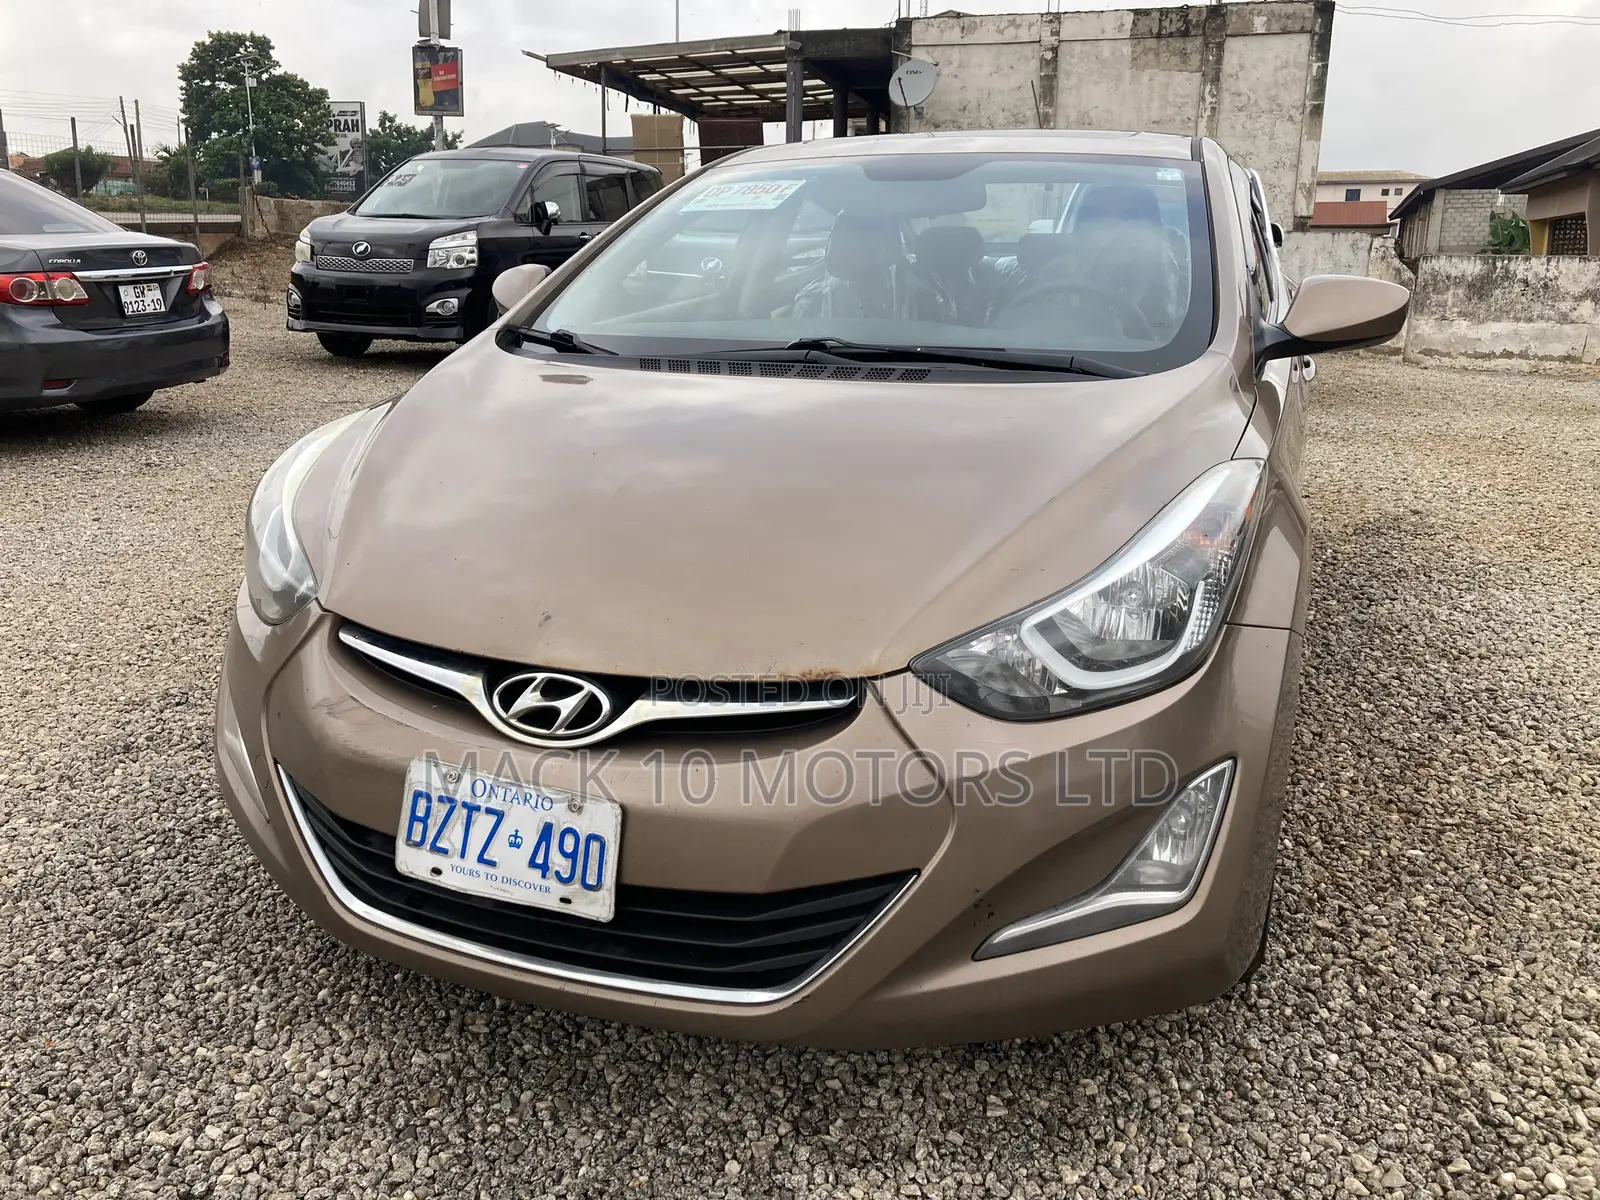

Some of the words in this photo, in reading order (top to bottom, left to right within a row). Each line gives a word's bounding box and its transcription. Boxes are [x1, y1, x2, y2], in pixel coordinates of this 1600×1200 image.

[133, 285, 146, 298] GW
[123, 298, 163, 314] 9123-19
[405, 789, 505, 868] BZTZ
[527, 821, 607, 892] 490
[450, 863, 481, 879] YOURS
[484, 871, 498, 882] TO
[501, 876, 552, 894] DISCOVER
